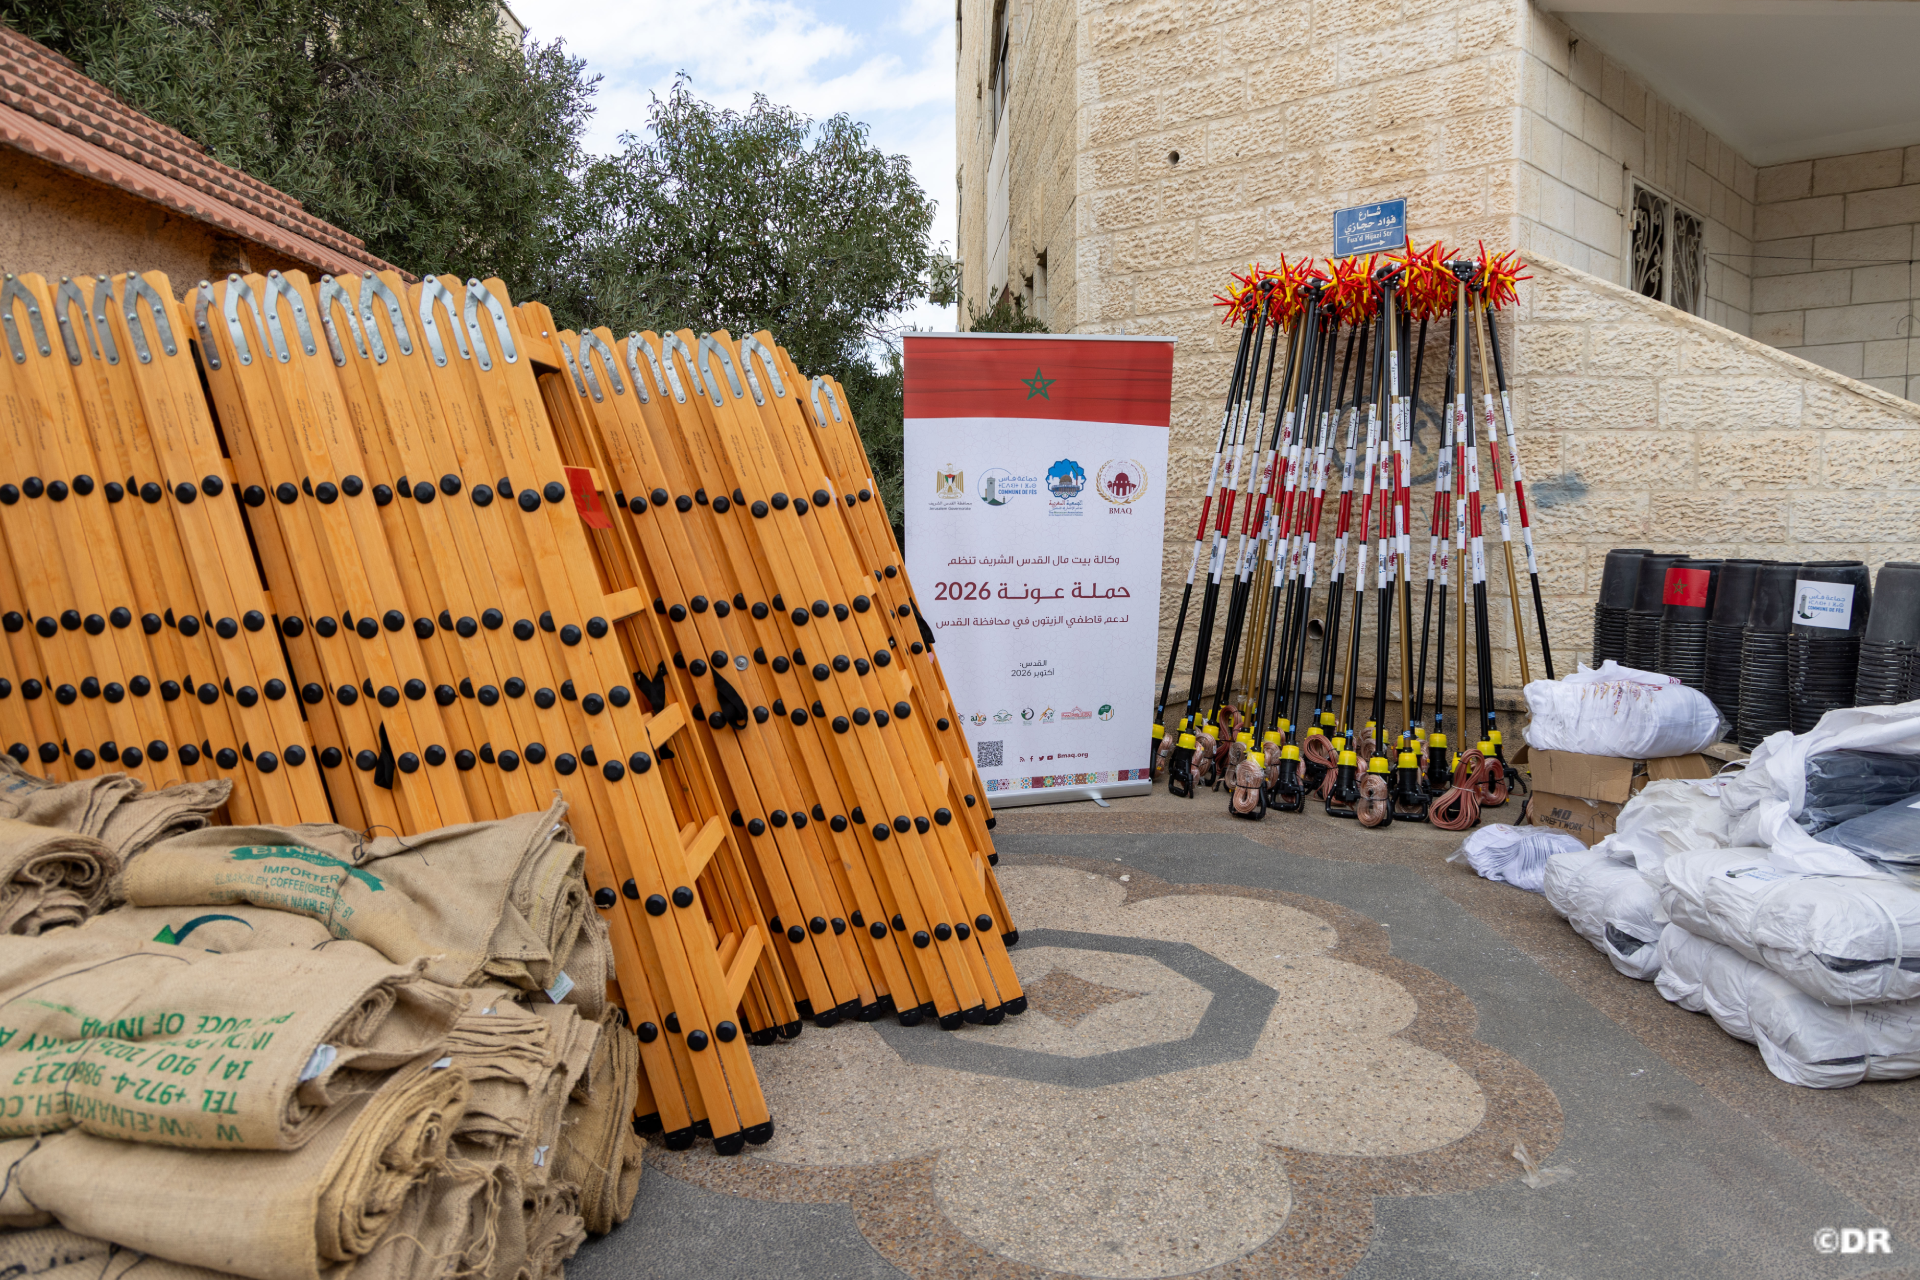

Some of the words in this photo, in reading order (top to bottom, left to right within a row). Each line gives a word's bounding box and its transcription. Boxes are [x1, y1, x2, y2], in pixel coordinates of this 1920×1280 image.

[1358, 206, 1381, 221] شارع
[1378, 215, 1396, 226] فؤاد
[1344, 222, 1374, 235] حجازي
[1365, 232, 1381, 241] Hijazi
[948, 556, 976, 566] تنظم
[979, 554, 1014, 567] الشريف
[1017, 555, 1050, 567] القدس
[1053, 556, 1069, 566] مال
[1072, 557, 1091, 566] بيت
[1094, 555, 1120, 566] وكالة
[935, 582, 991, 600] 2026
[998, 583, 1064, 604] عونة
[1072, 582, 1130, 599] حملة
[936, 618, 970, 629] القدس
[973, 618, 1010, 626] محافظة
[1013, 617, 1029, 629] في
[1032, 616, 1063, 627] الزيتون
[1066, 616, 1102, 628] قاطفي
[1104, 615, 1128, 625] لدعم
[1020, 660, 1047, 668] القدس:
[1033, 668, 1054, 678] أكتوبر
[264, 865, 340, 883] IMPORTER
[250, 890, 261, 902] OF
[291, 895, 330, 916] NAKHLEH
[153, 1013, 185, 1035] OF
[157, 1054, 202, 1076] 910
[223, 1060, 253, 1081] 14
[12, 1061, 106, 1086] 9860213
[202, 1089, 238, 1114] TEL
